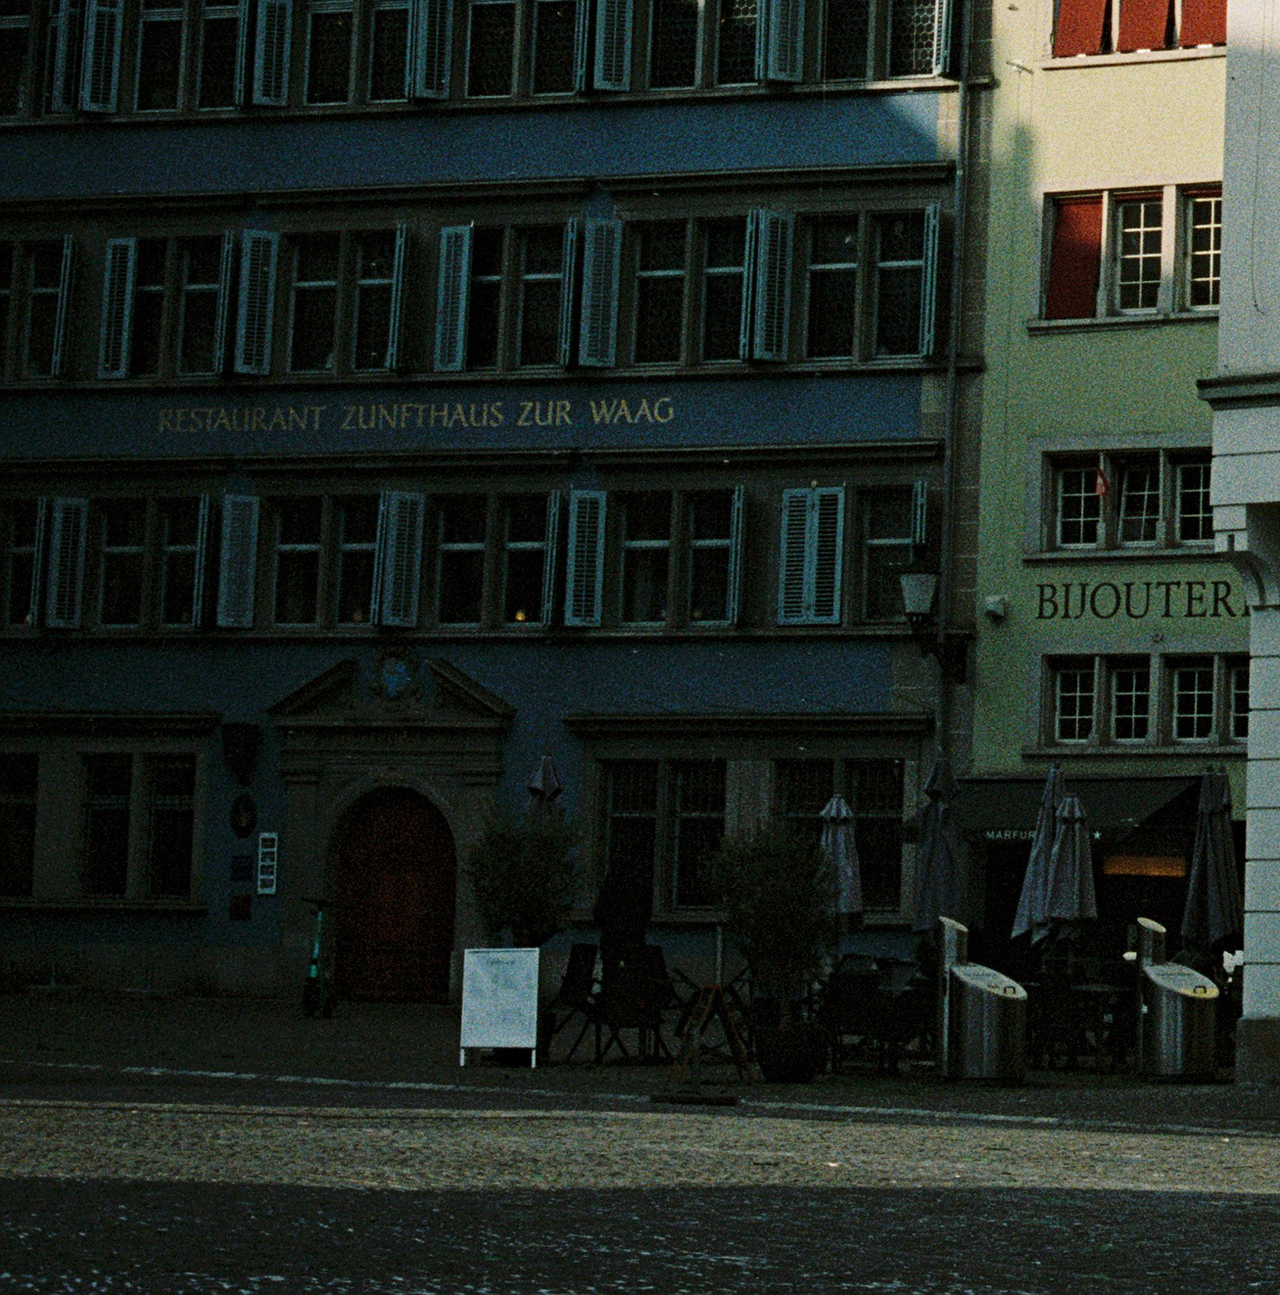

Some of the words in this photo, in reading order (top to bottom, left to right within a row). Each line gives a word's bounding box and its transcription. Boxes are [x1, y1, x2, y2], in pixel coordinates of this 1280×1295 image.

[157, 405, 325, 434] RESTAURANT
[339, 401, 504, 431] ZUNFTHAUS
[516, 400, 573, 427] ZUR
[591, 396, 675, 425] WAAG
